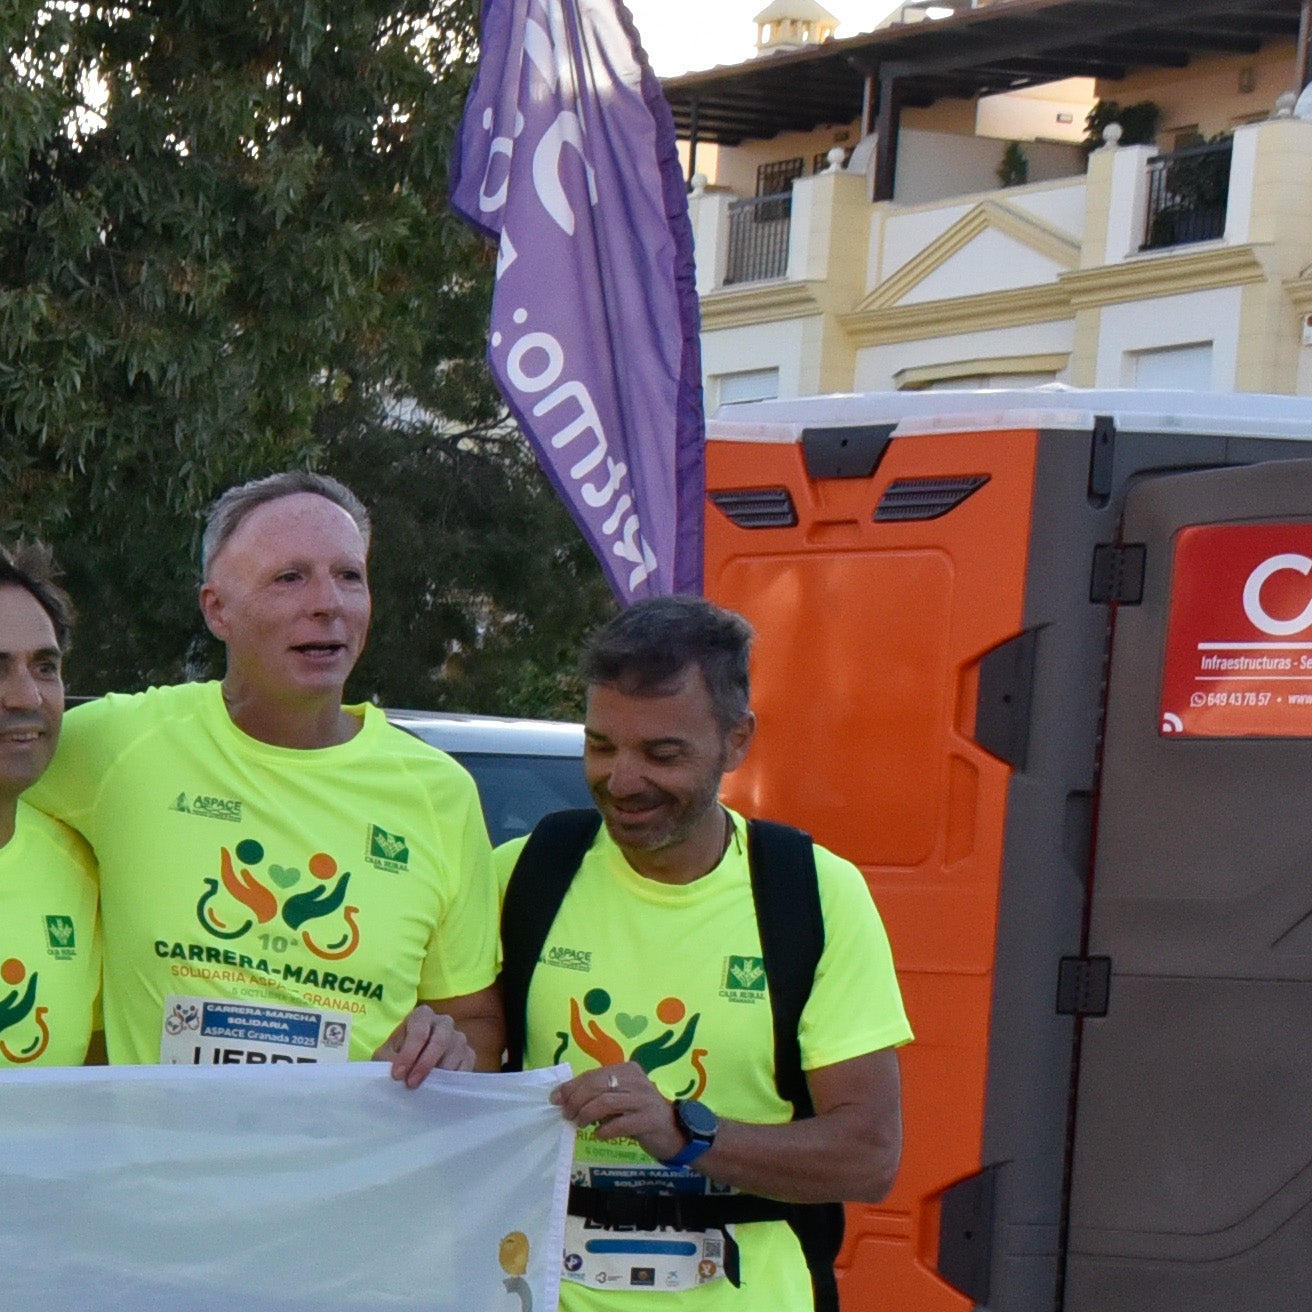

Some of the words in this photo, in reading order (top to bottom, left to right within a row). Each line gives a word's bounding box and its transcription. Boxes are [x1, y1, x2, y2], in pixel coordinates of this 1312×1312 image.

[1201, 655, 1291, 670] Infraestructuras
[1228, 692, 1242, 706] 43
[194, 795, 242, 811] ASPACE
[154, 940, 384, 1001] CARRERA-MARCHA
[171, 965, 246, 985] SOLIDARIA
[303, 992, 367, 1015] GRANADA
[207, 1004, 318, 1023] CARRERA-MARCHA
[228, 1017, 289, 1031] SOLIDARIA
[205, 1027, 246, 1038] ASPACE
[248, 1030, 290, 1042] Granada
[292, 1034, 315, 1046] 2025
